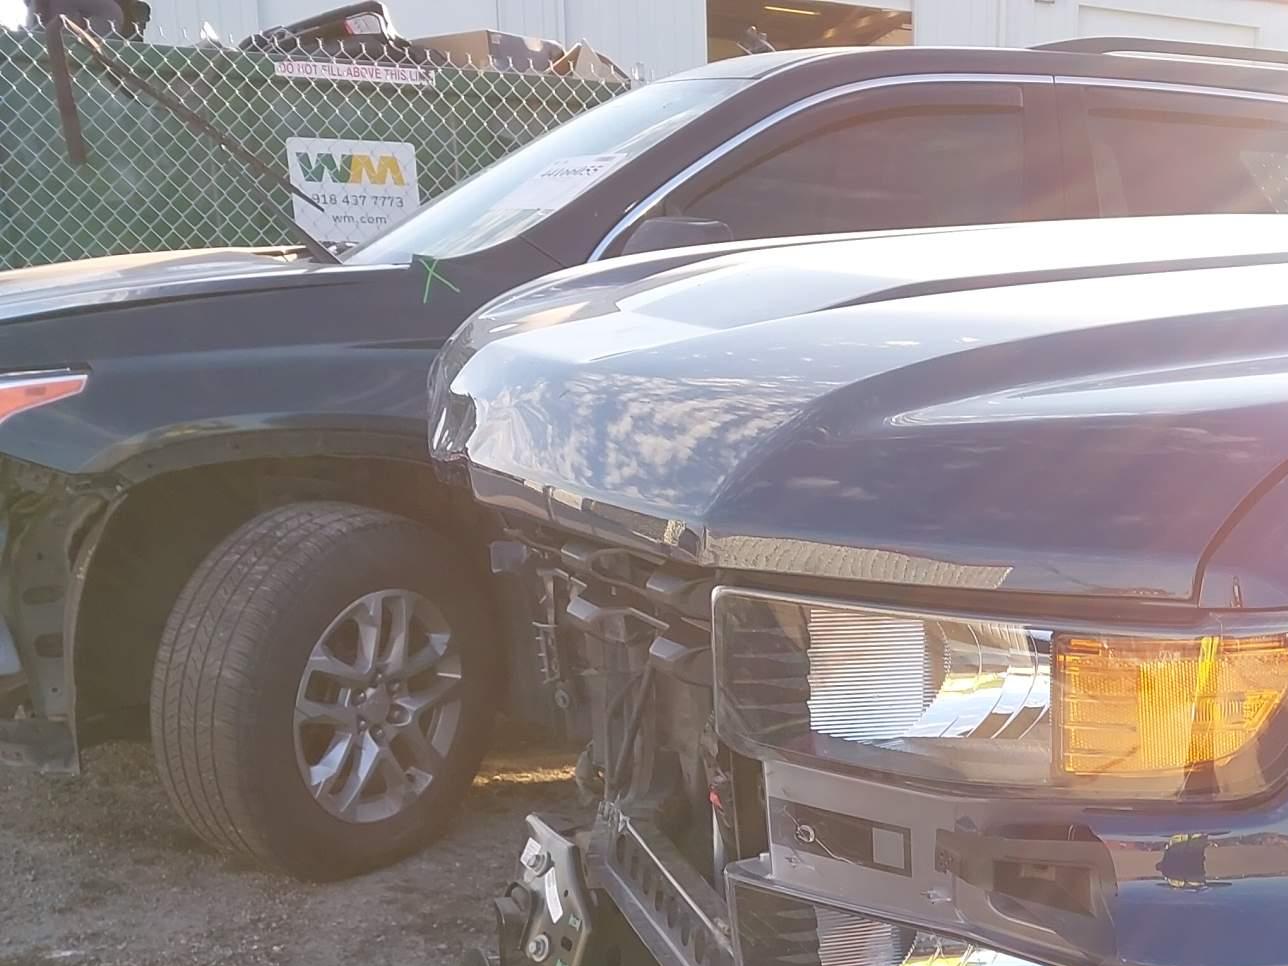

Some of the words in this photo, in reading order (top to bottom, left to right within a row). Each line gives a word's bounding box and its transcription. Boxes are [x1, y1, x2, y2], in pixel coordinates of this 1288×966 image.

[279, 63, 294, 74] DO
[297, 64, 318, 75] NOT
[322, 66, 343, 77] FILL
[347, 67, 381, 79] ABOVE
[384, 69, 407, 81] THIS
[295, 151, 406, 186] WM
[312, 193, 337, 205] 918
[342, 194, 367, 206] 437
[371, 196, 405, 208] 7773
[332, 214, 387, 225] wm.com
